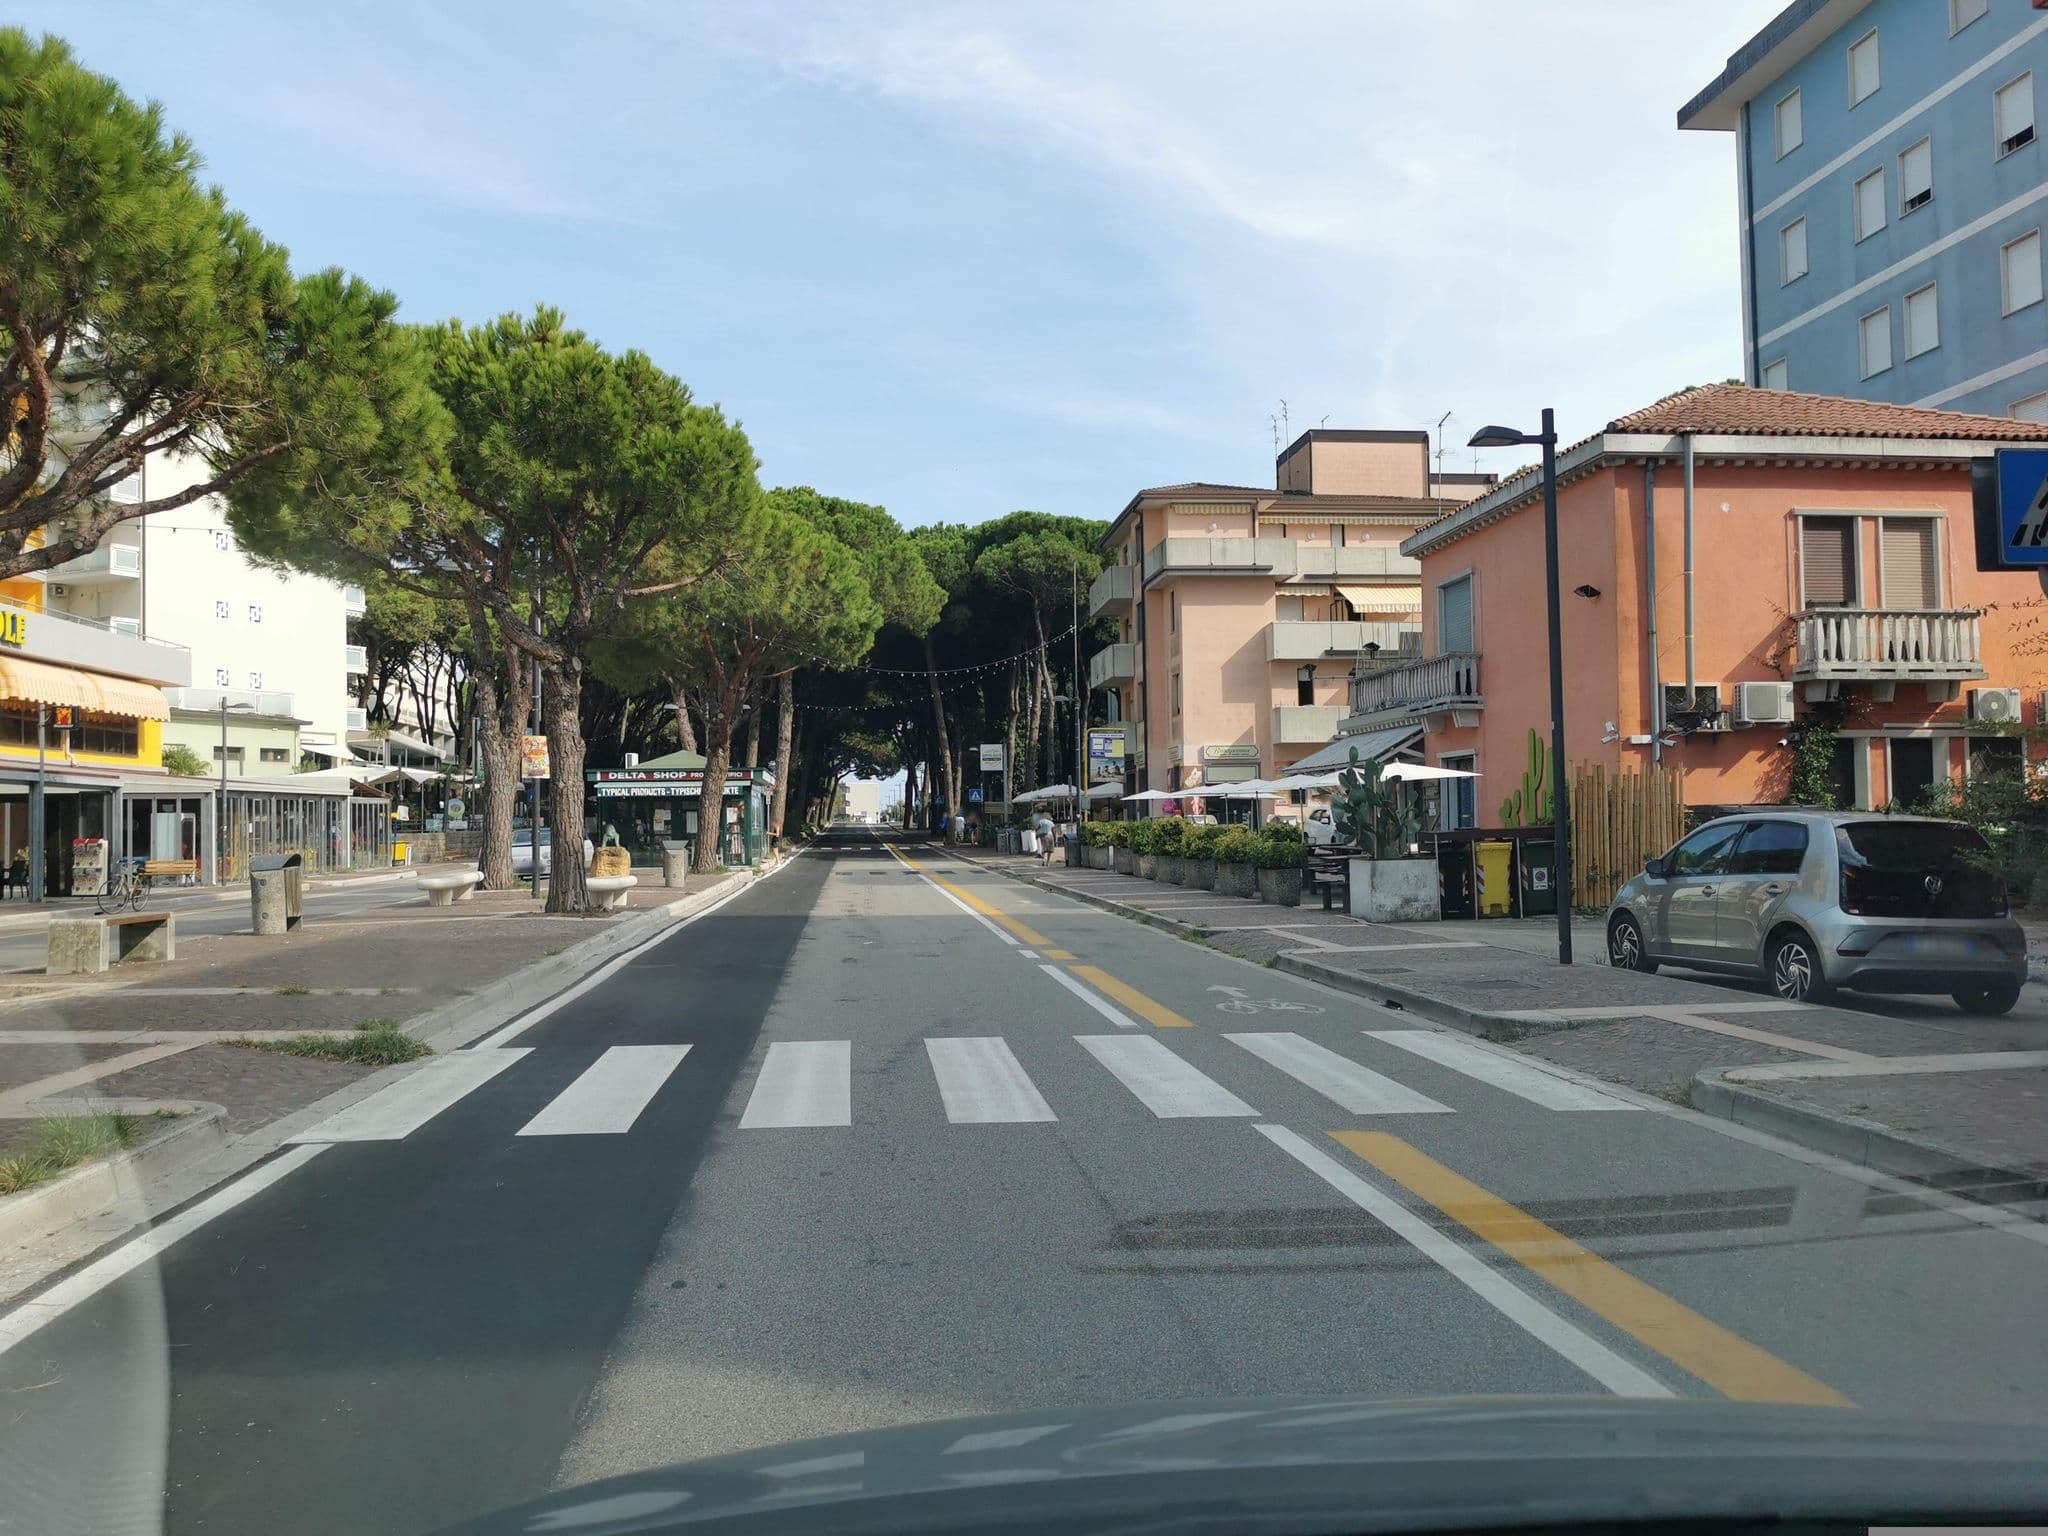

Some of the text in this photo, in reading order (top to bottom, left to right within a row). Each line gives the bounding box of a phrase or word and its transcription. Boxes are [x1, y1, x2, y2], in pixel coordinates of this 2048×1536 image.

[608, 772, 647, 780] DELTA
[653, 772, 687, 780] SHOP
[602, 788, 630, 797] TYPICAL
[631, 788, 666, 797] PRODUCTS
